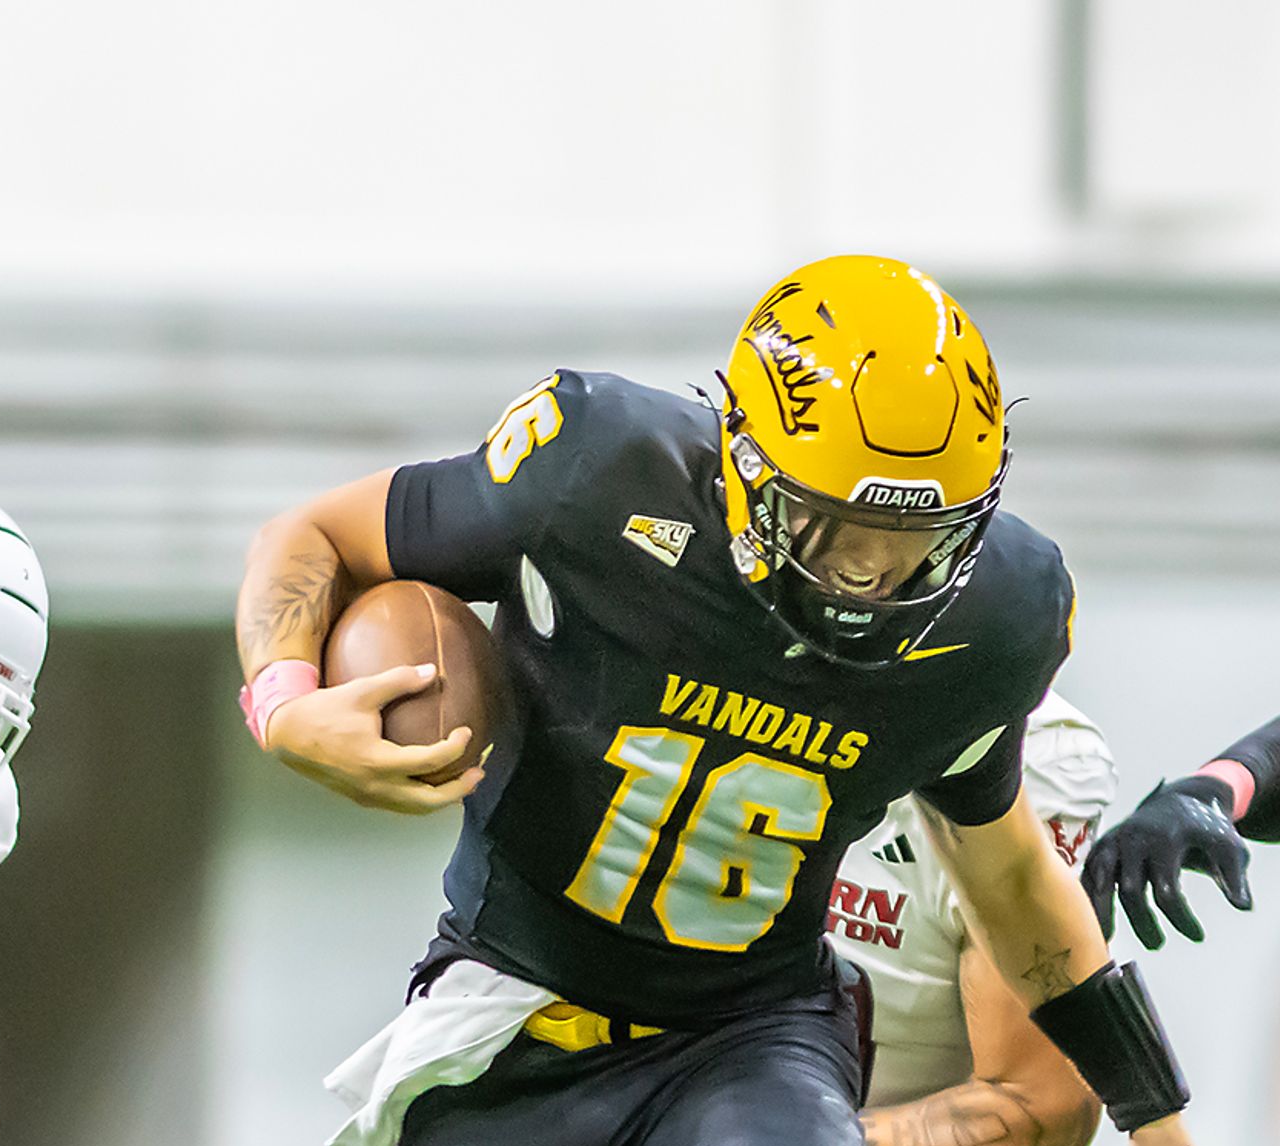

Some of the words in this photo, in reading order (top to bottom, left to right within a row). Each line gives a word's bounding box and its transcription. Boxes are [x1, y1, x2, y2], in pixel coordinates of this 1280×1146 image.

[865, 485, 937, 507] IDAHO
[659, 673, 869, 770] VANDALS
[564, 725, 832, 952] 16
